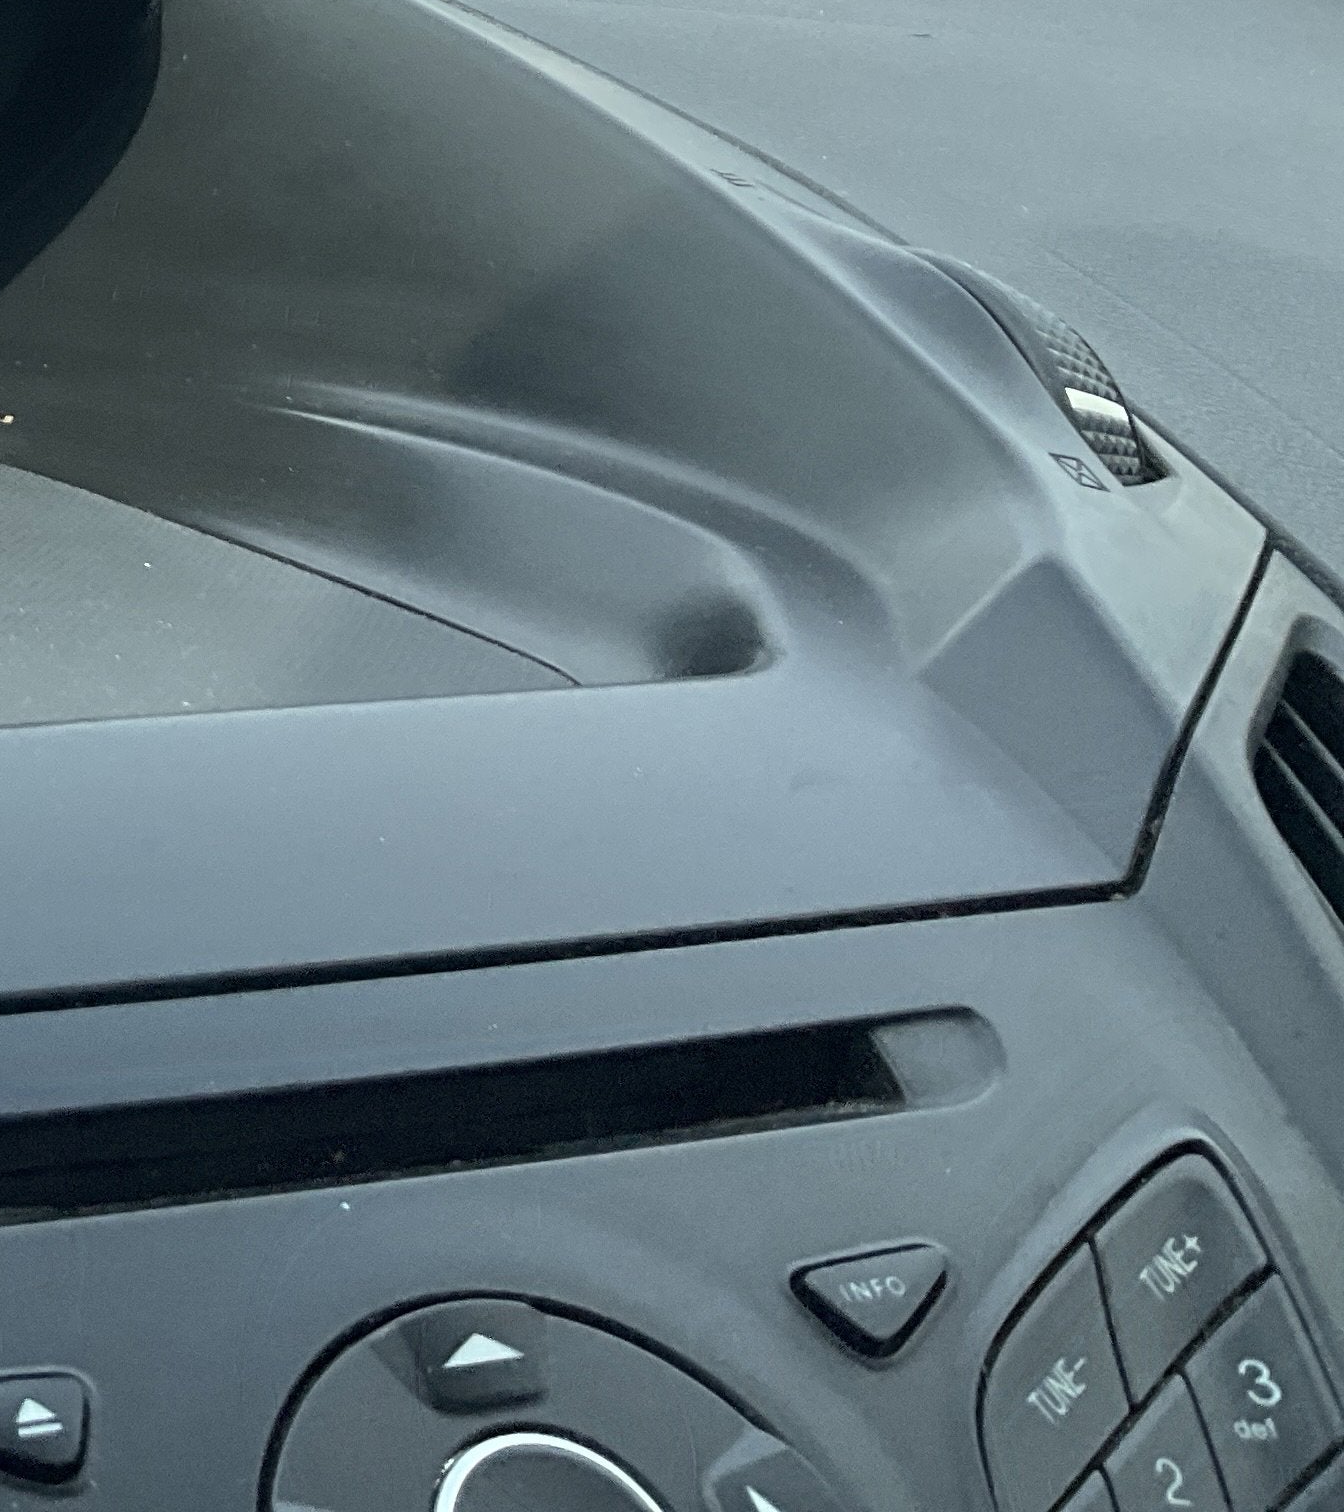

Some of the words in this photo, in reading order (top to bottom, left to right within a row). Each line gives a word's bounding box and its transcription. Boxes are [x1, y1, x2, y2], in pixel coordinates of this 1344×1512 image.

[838, 1274, 907, 1303] INFO
[1237, 1358, 1282, 1407] 3
[1154, 1457, 1192, 1508] 2
